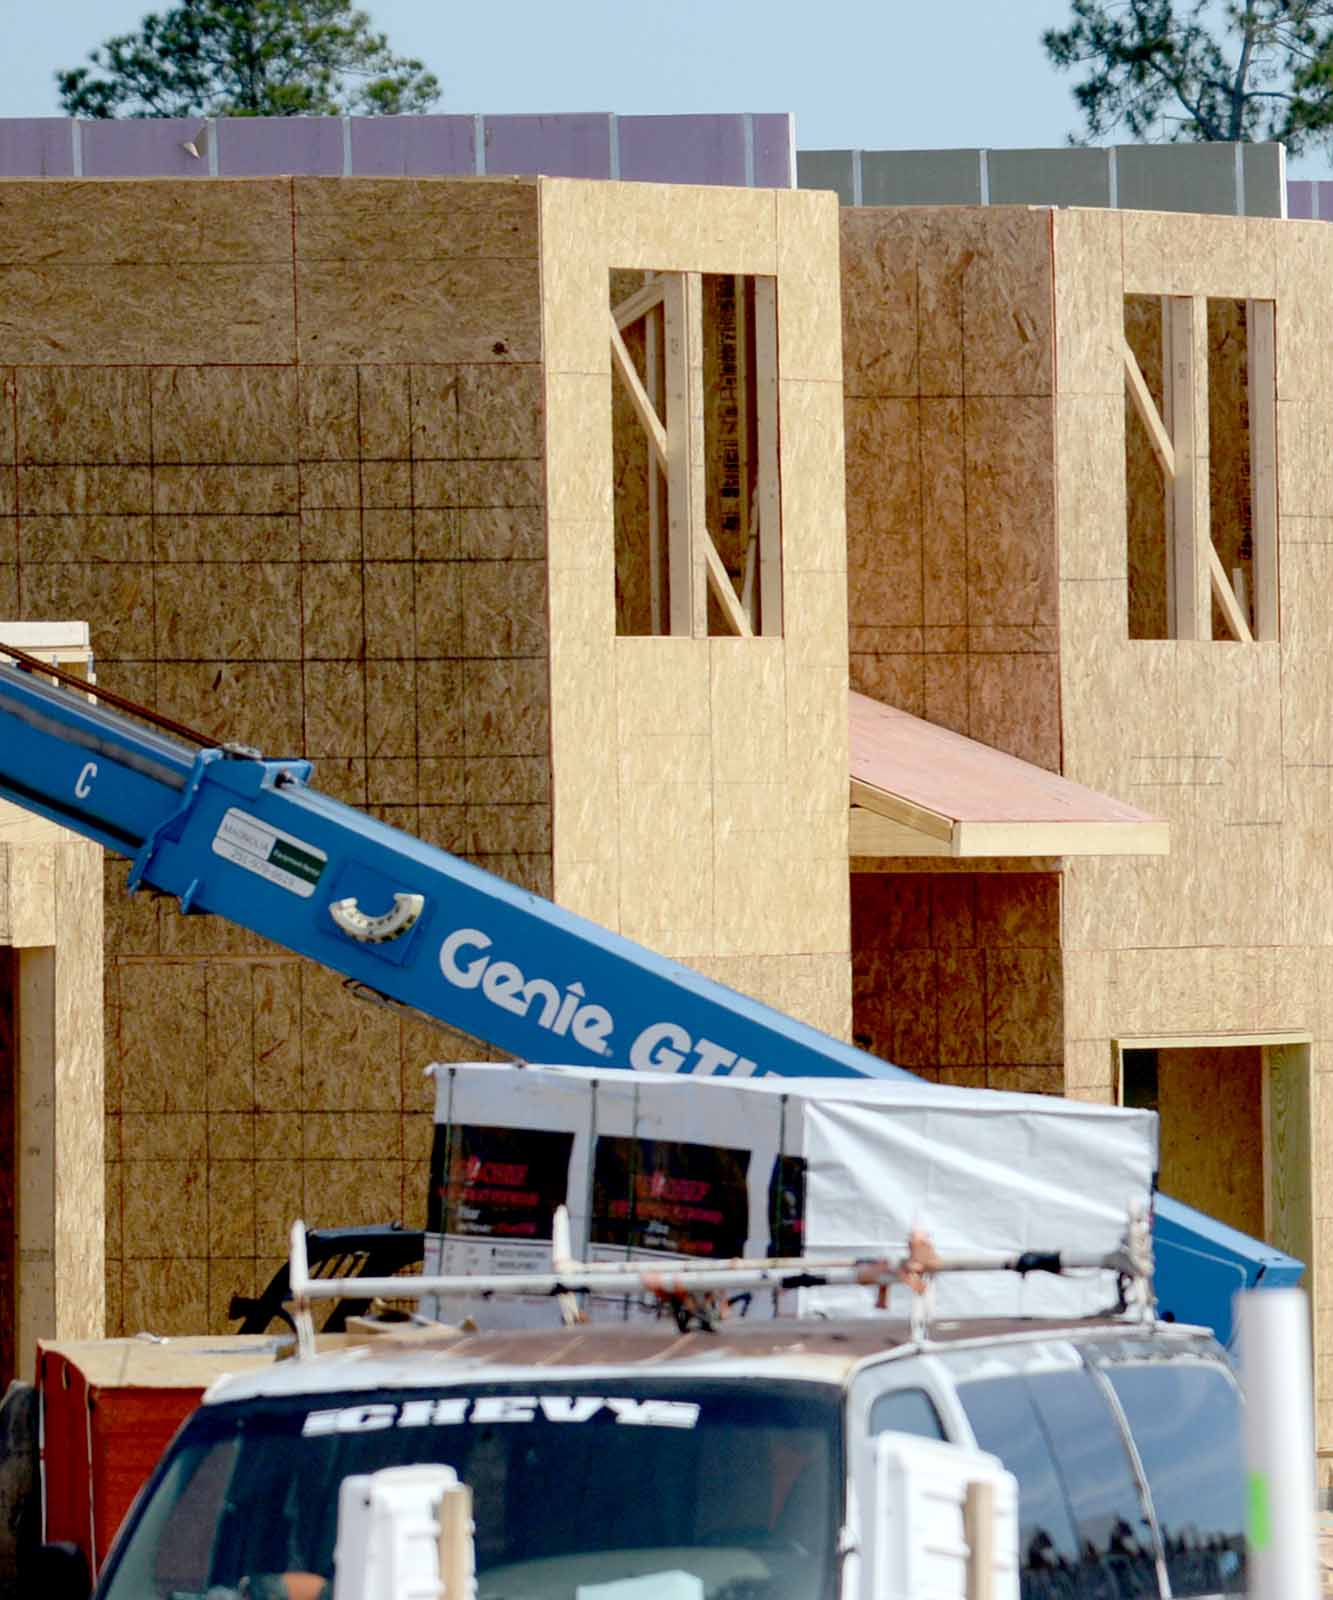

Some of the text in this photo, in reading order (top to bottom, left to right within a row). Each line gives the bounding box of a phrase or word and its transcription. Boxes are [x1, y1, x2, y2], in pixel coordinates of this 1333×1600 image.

[75, 762, 98, 799] C
[439, 928, 615, 1056] Genie
[302, 1396, 702, 1438] CHEVY
